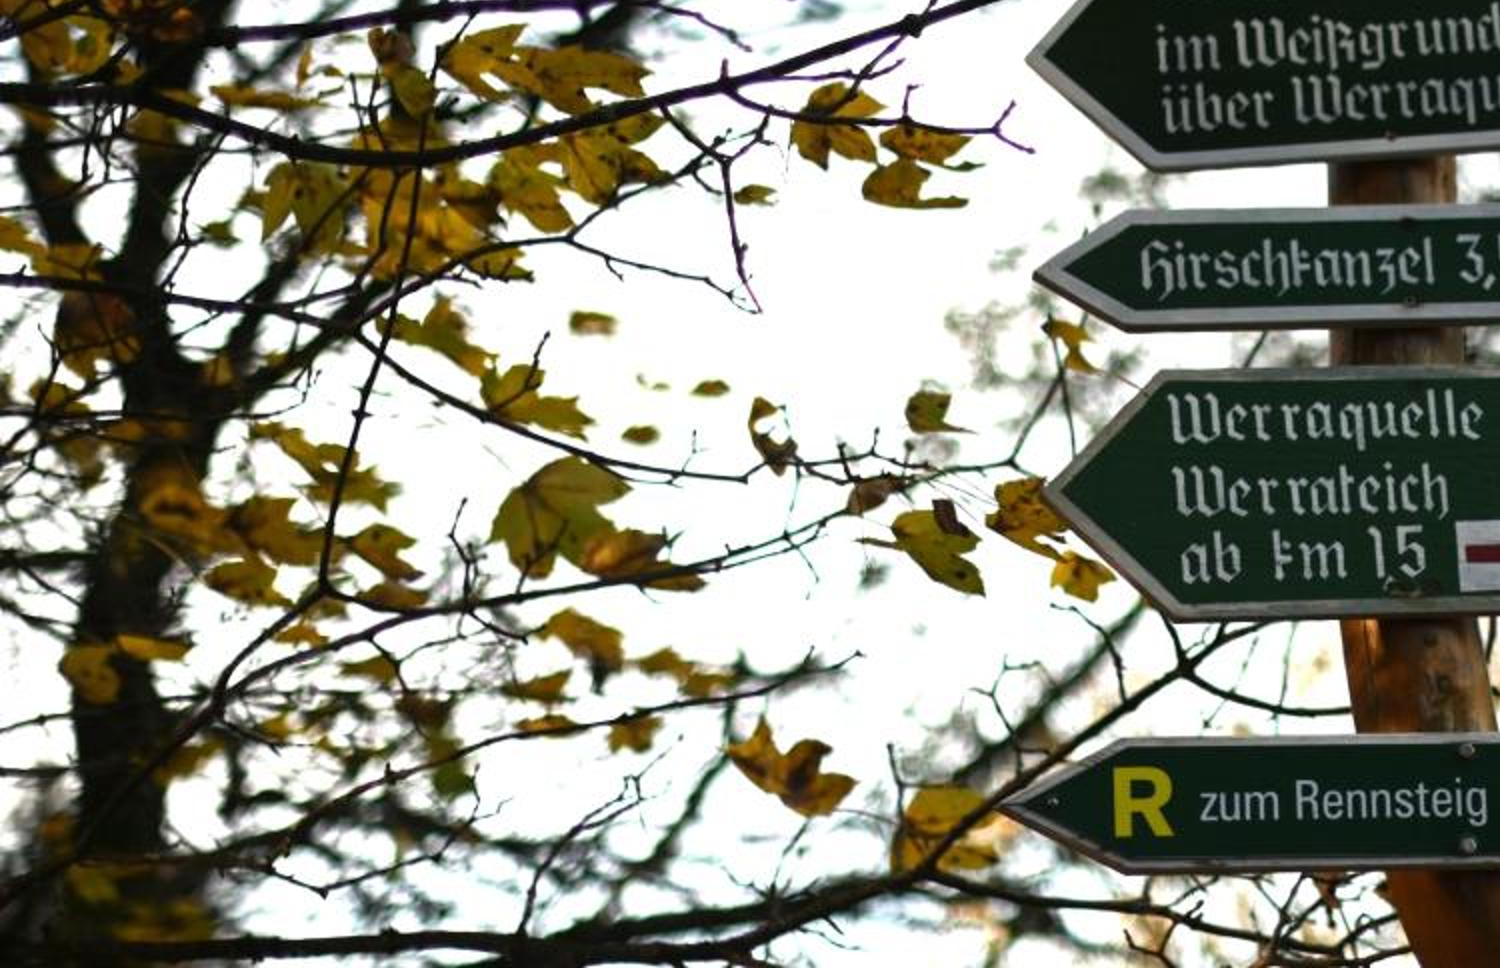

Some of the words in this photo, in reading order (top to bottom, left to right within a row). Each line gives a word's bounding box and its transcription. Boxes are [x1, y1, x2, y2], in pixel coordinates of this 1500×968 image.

[1156, 23, 1221, 73] im
[1161, 82, 1274, 134] über
[1140, 236, 1435, 300] Hirschkanzel
[1167, 388, 1484, 452] Werraquelle
[1171, 462, 1449, 518] Werrateich
[1180, 529, 1242, 585] ab
[1271, 529, 1348, 581] km
[1113, 766, 1174, 838] R
[1200, 791, 1280, 822] zum
[1295, 776, 1488, 827] Rennsteig
